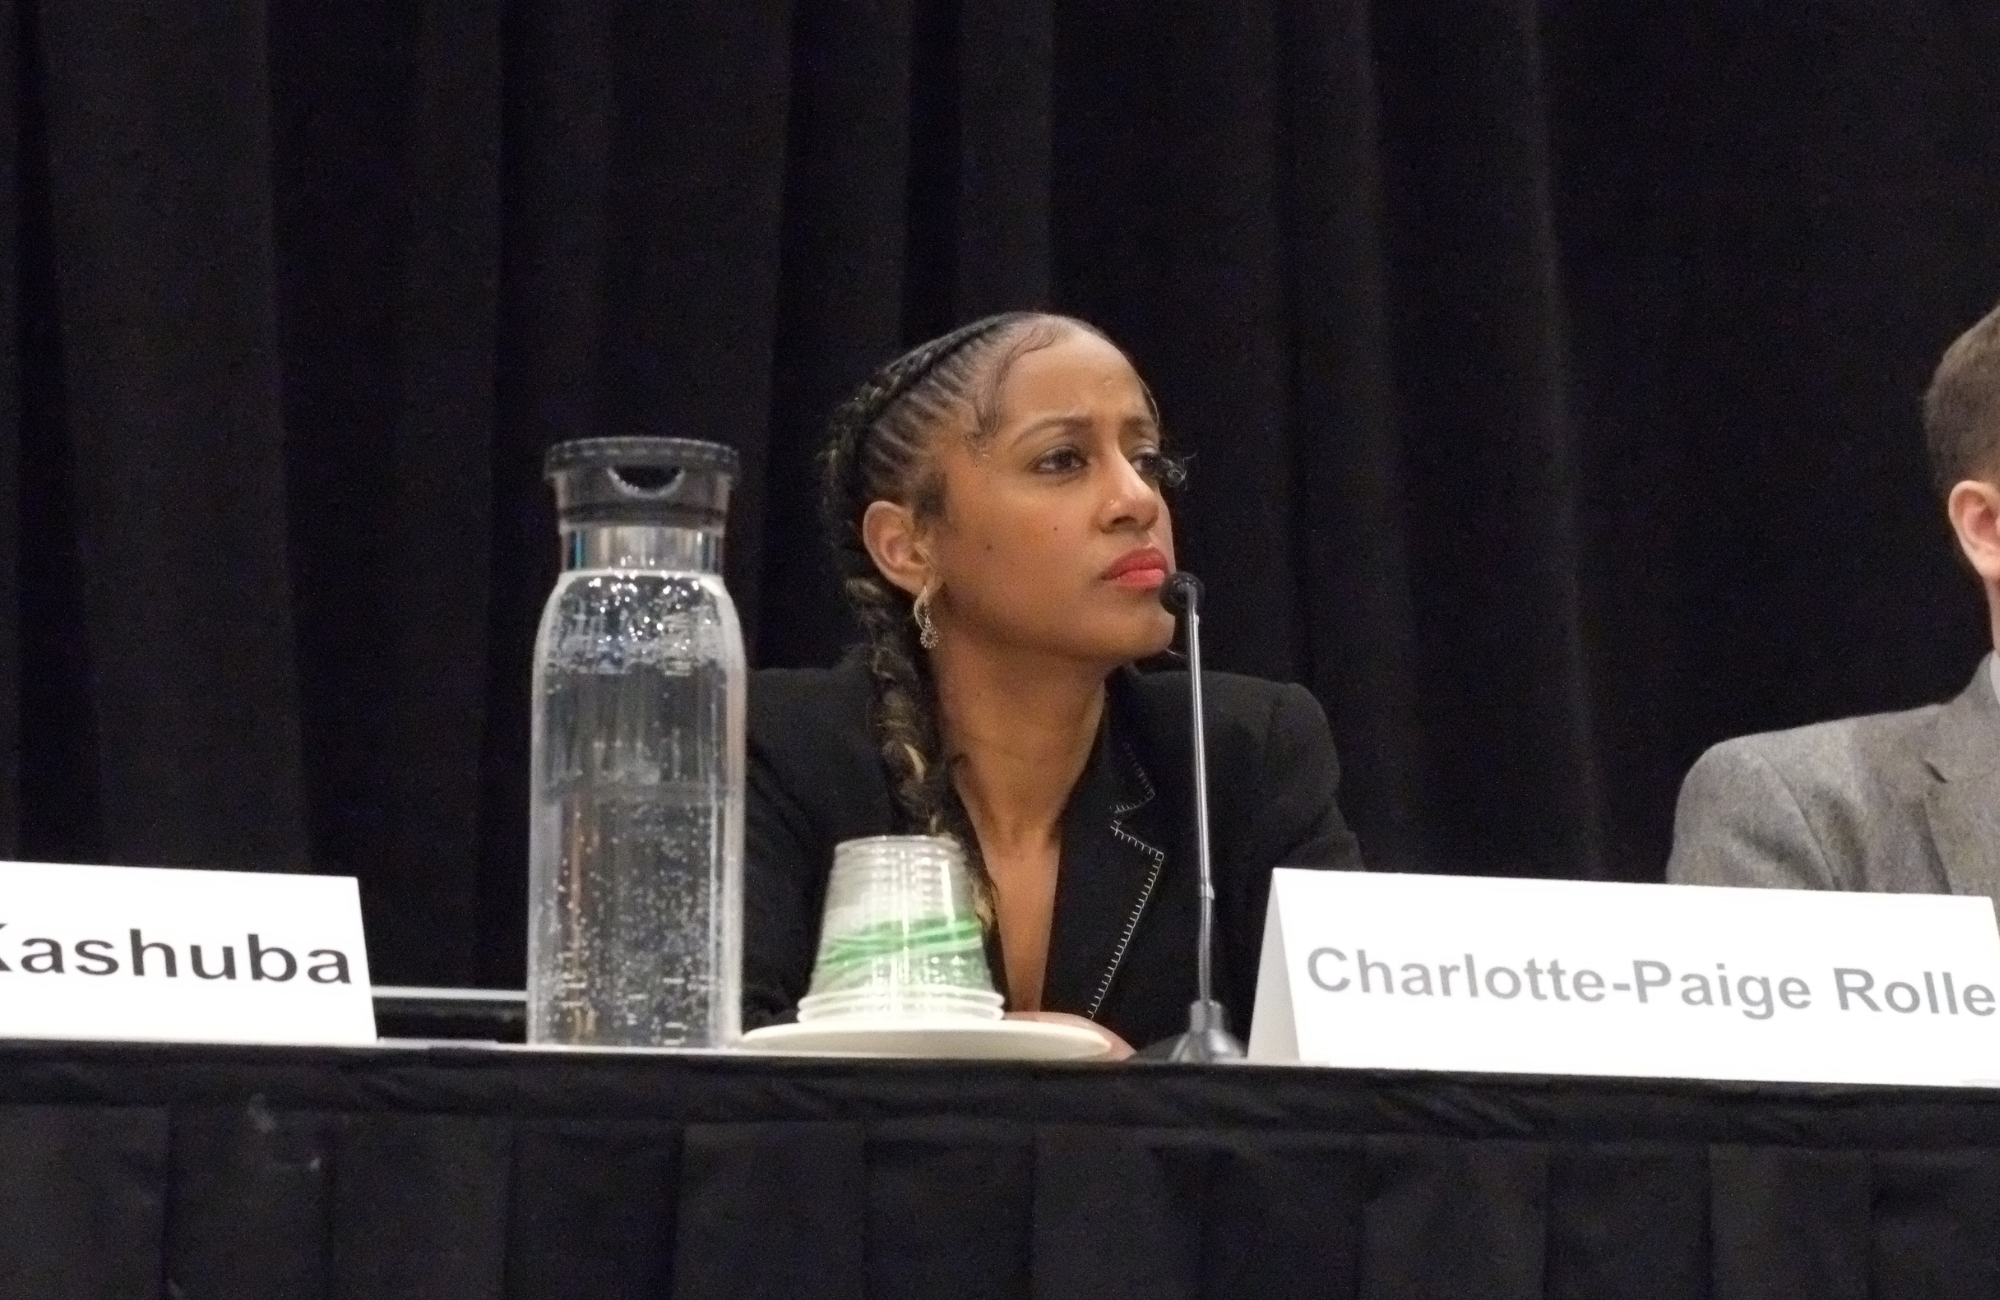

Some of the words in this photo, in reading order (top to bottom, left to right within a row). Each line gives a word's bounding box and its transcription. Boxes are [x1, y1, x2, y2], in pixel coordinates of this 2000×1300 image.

[0, 921, 352, 985] ashuba
[1307, 947, 1811, 1020] Charlotte-Paige
[1833, 967, 1996, 1017] Rolle
